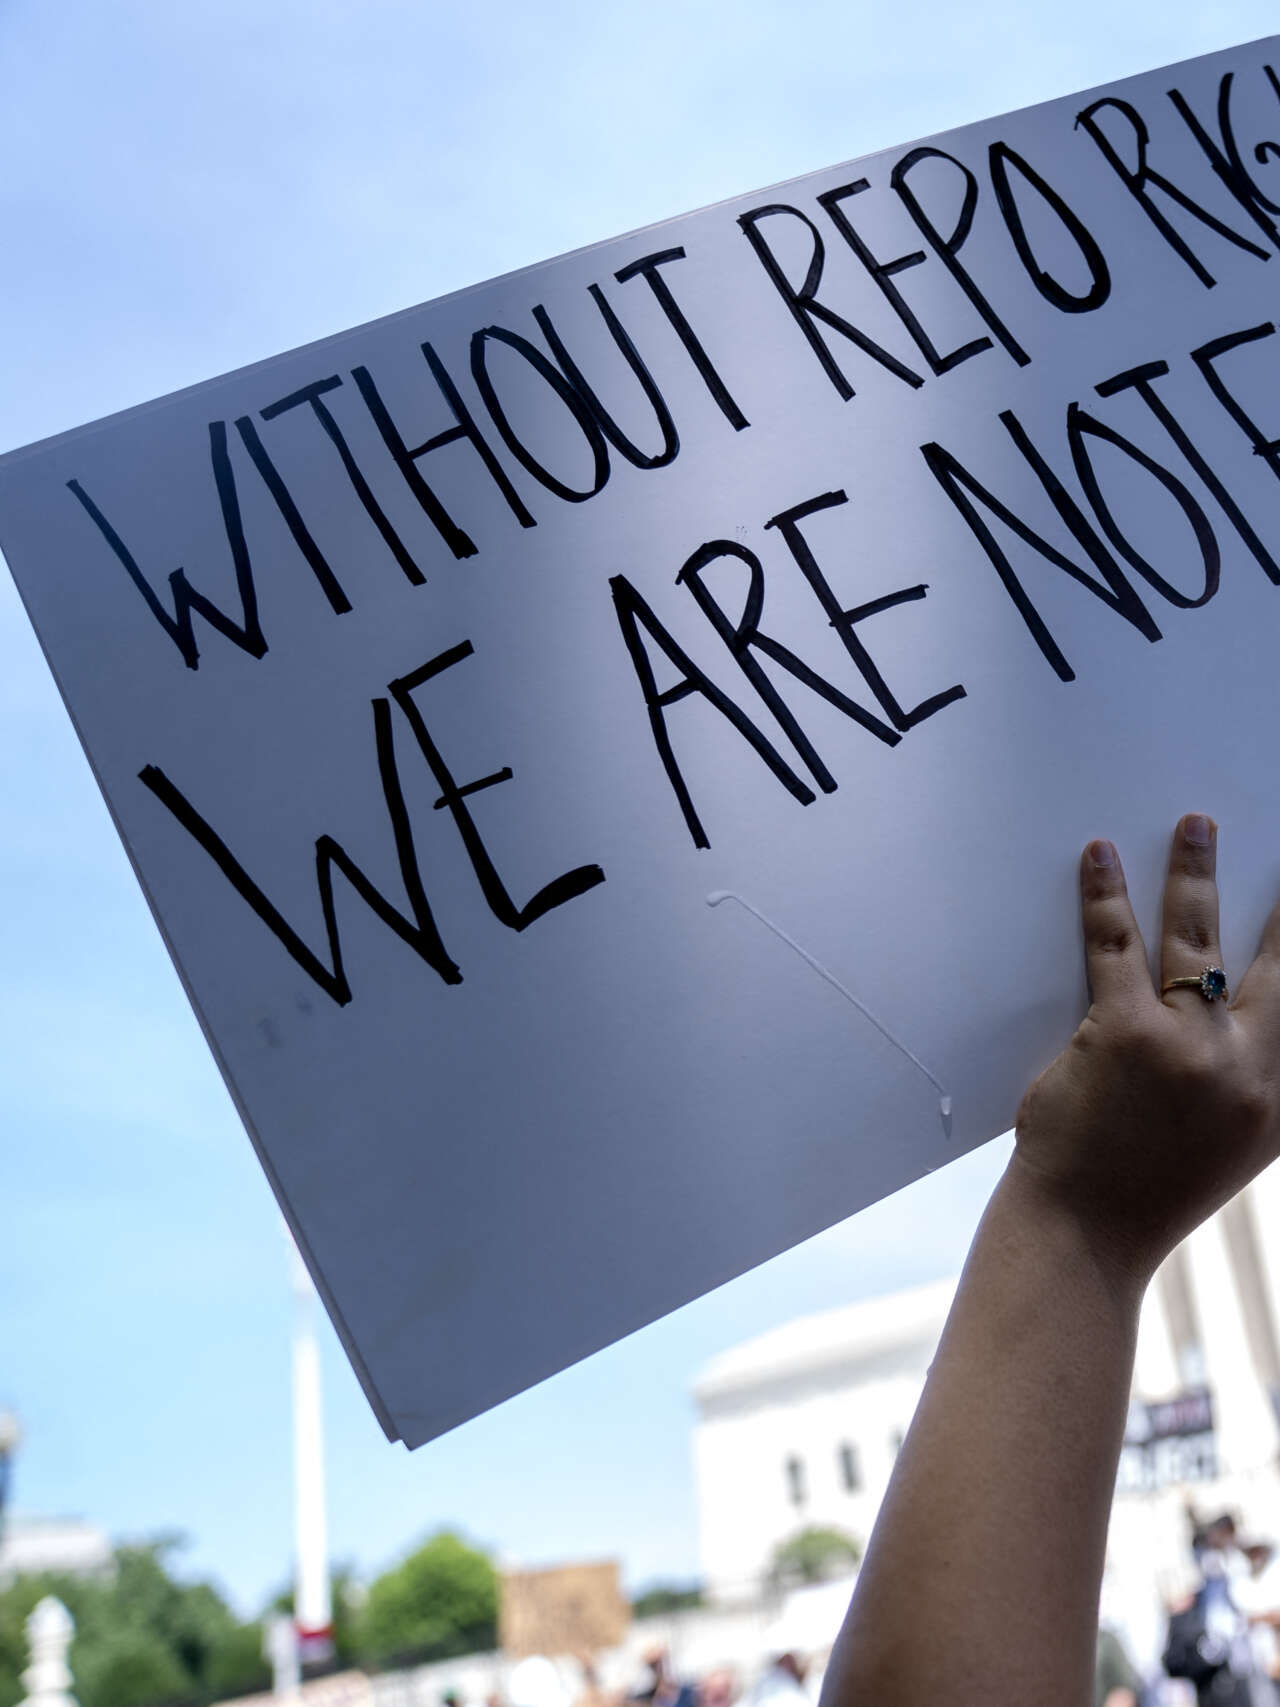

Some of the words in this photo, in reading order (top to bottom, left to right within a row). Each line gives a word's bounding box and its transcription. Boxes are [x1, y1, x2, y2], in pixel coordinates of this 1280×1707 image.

[65, 246, 751, 672] WITHOUT
[737, 140, 1112, 402] REPO
[136, 639, 606, 1009] WE
[608, 489, 968, 850] ARE
